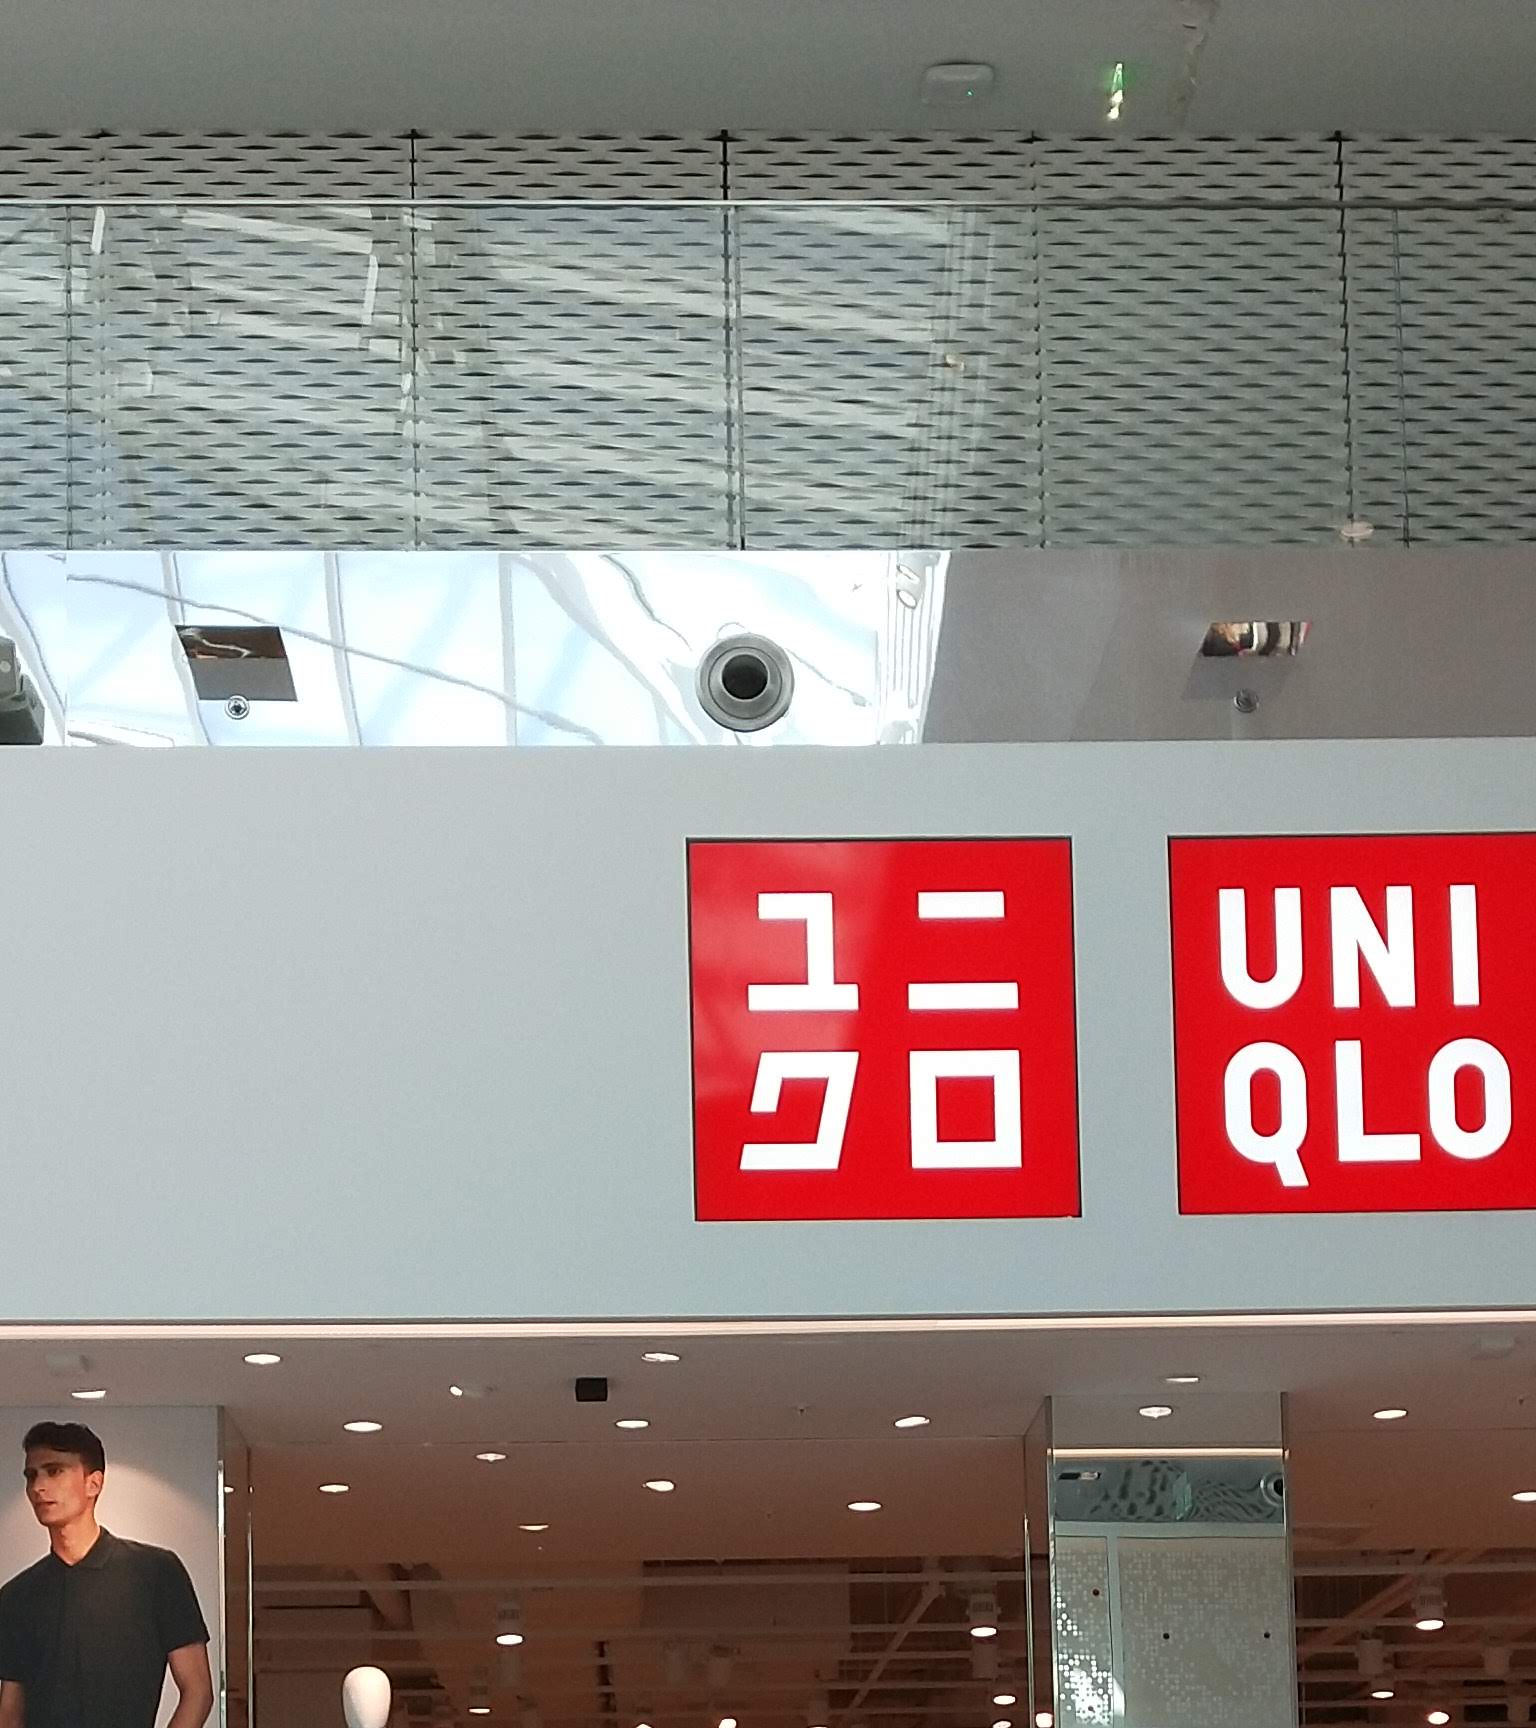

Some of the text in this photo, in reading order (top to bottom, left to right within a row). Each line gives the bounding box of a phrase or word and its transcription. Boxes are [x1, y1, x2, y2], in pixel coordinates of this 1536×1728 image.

[747, 890, 1019, 1012] ユニ
[1218, 883, 1481, 1009] UNI
[739, 1049, 1023, 1171] クロ
[1223, 1037, 1513, 1188] QLO
